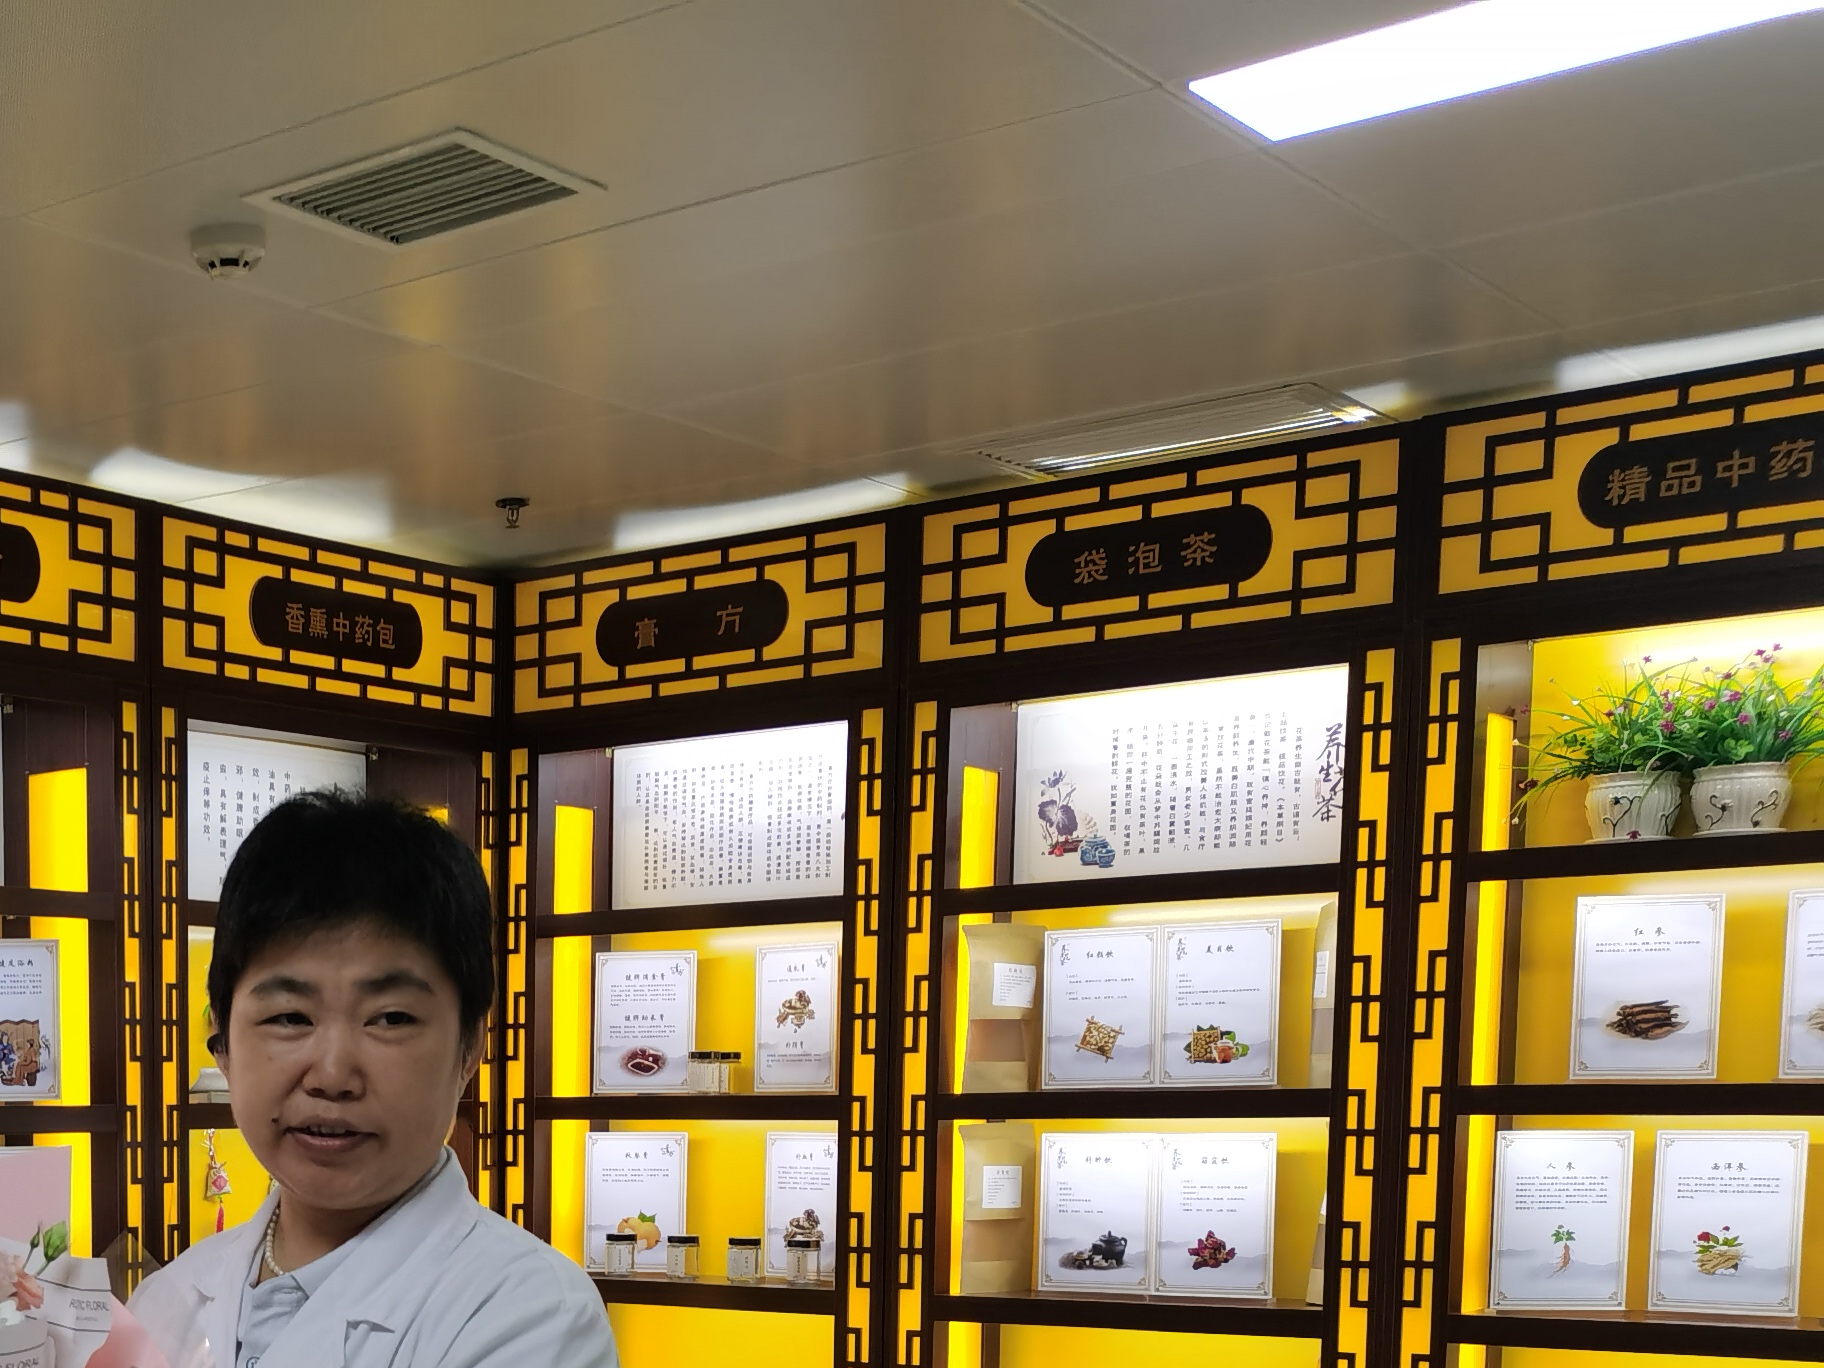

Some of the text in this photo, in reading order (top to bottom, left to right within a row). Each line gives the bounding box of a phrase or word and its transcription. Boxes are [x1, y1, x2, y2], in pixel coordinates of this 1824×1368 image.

[1603, 438, 1816, 506] 精品中药
[1074, 531, 1218, 585] 袋泡茶
